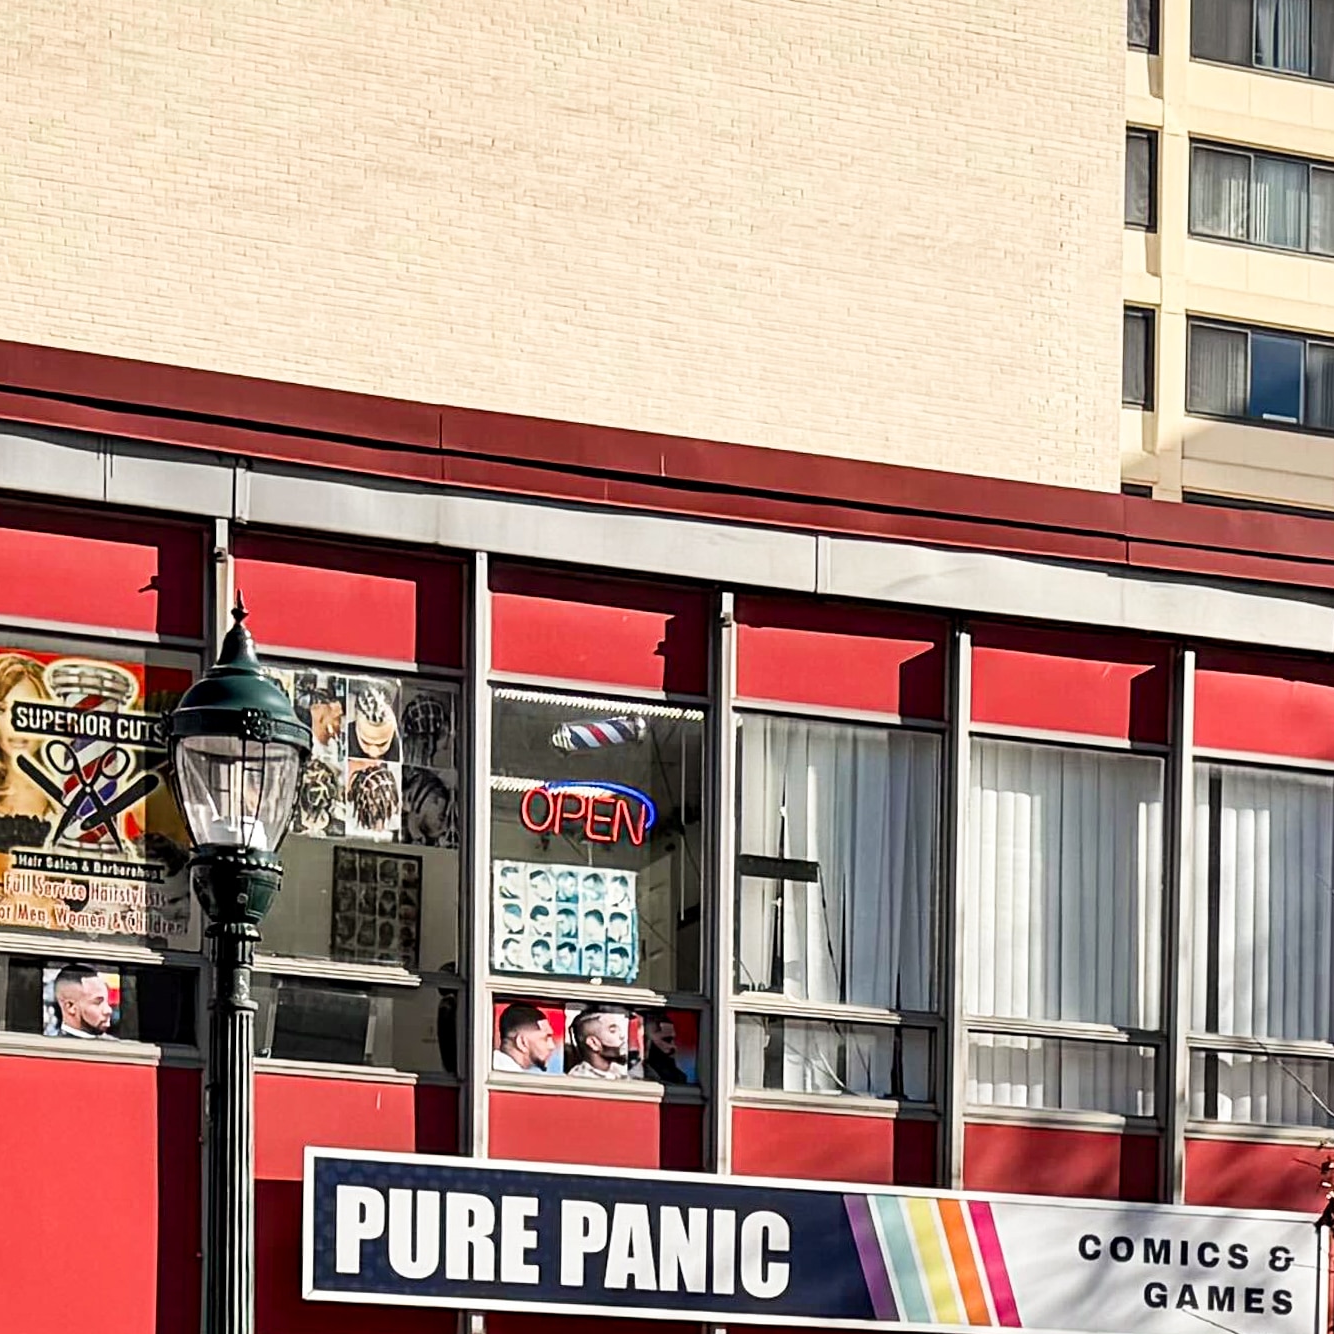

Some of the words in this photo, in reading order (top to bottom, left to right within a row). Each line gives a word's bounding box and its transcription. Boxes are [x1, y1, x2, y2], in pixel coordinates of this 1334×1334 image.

[16, 706, 111, 737] SUPERIOR
[117, 717, 164, 745] CUTS
[521, 787, 647, 846] OPEN
[18, 853, 43, 868] Hair
[46, 856, 78, 872] Salon
[81, 858, 89, 872] &
[4, 871, 33, 896] Full
[34, 875, 87, 901] Service
[55, 904, 106, 930] Women
[335, 1184, 540, 1285] PURE
[560, 1198, 792, 1300] PANIC
[1078, 1233, 1249, 1270] COMICS
[1268, 1245, 1295, 1272] &
[1143, 1281, 1293, 1315] GAMES
